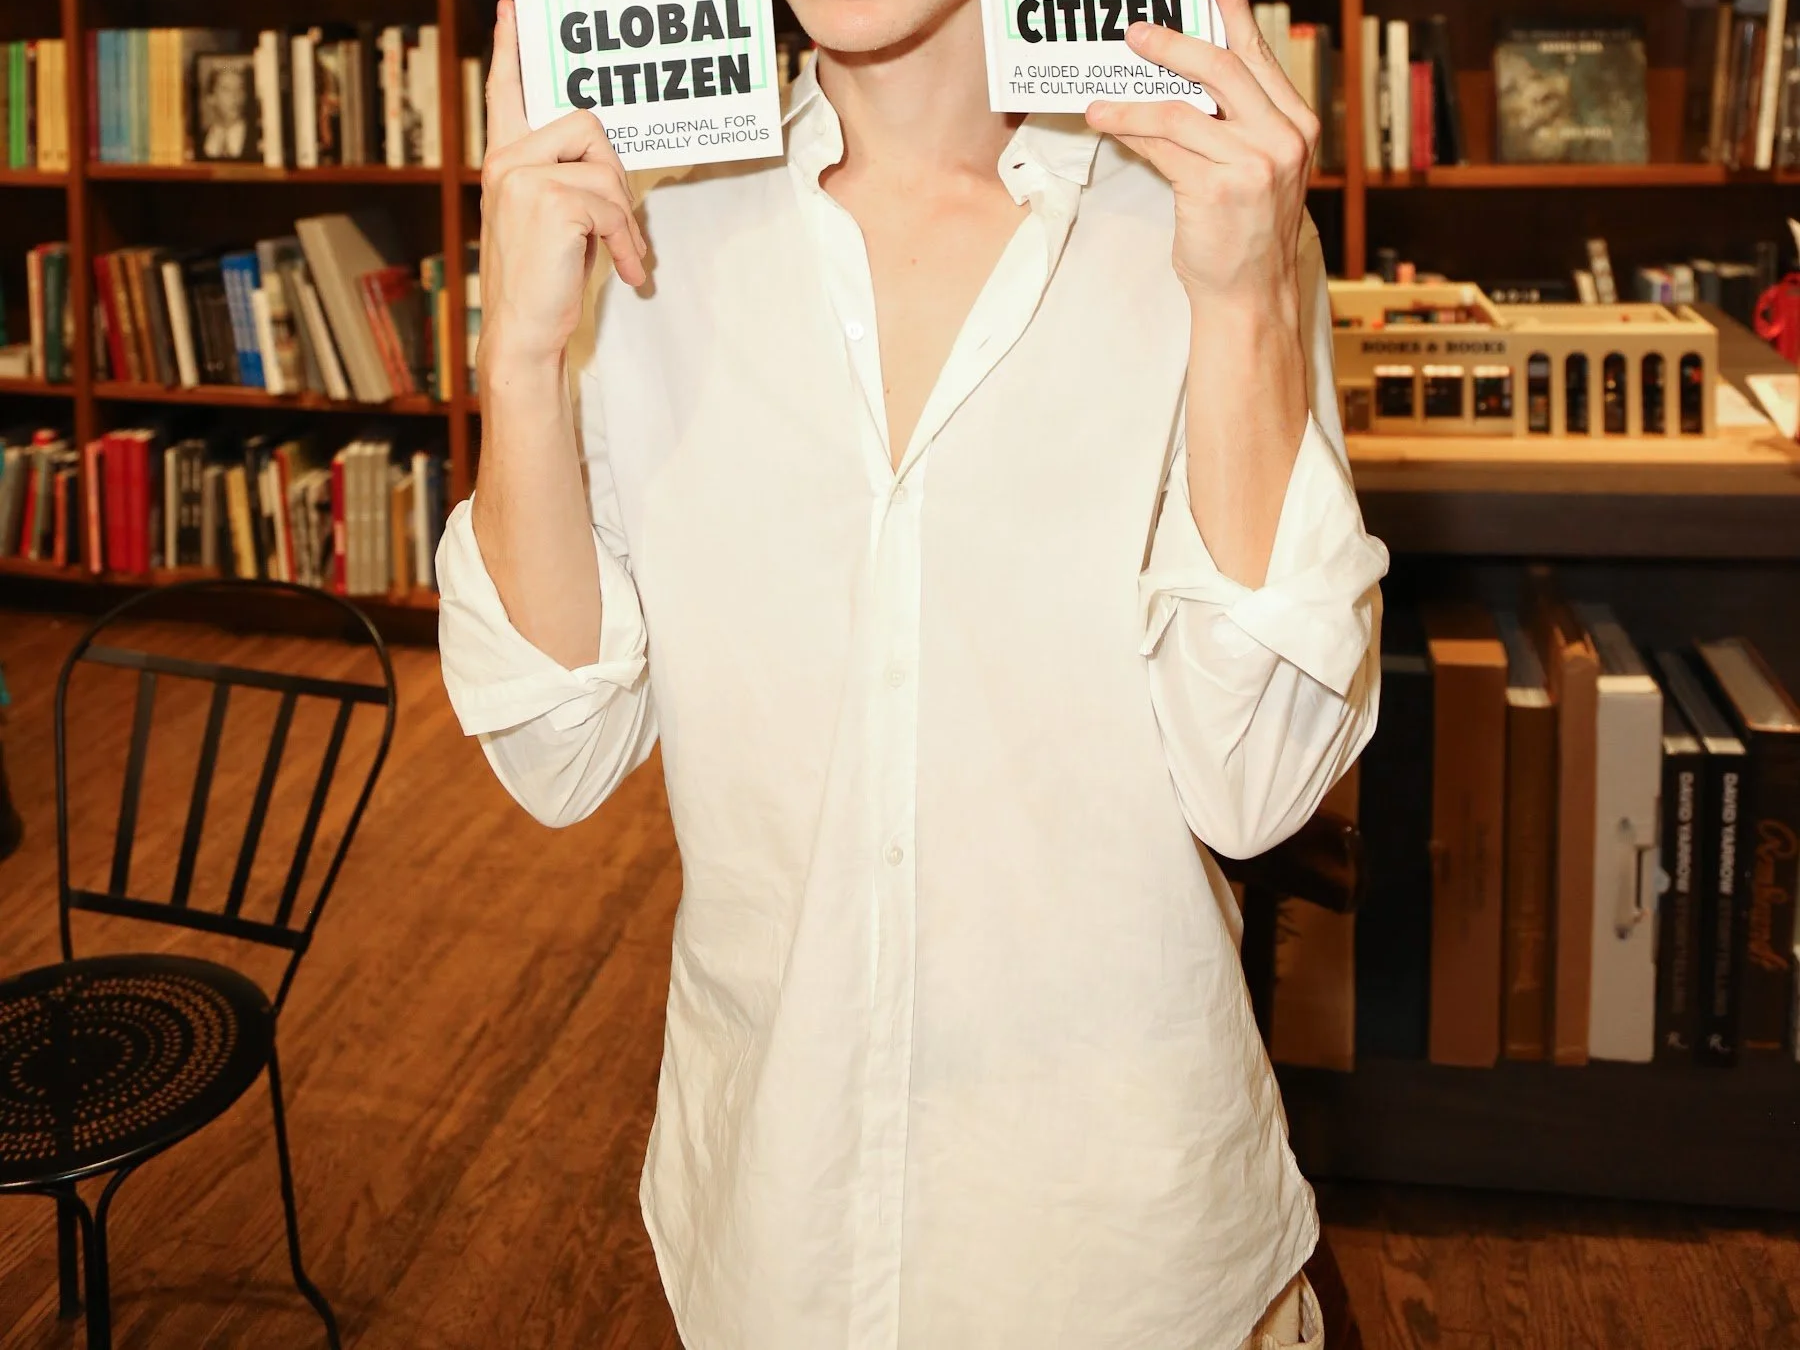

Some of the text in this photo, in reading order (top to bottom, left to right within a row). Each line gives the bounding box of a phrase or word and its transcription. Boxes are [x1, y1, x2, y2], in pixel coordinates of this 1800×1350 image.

[1014, 64, 1179, 78] A GUIDED JOURNAL FO
[566, 53, 751, 110] CITIZEN
[1009, 81, 1203, 95] THE CULTURALLY CURIOUS
[645, 119, 718, 137] JOURNAL
[724, 114, 756, 129] FOR
[697, 128, 770, 146] CURIOUS
[1445, 340, 1507, 355] BOOKS
[1678, 771, 1695, 823] DAVID
[1721, 772, 1739, 824] DAVID
